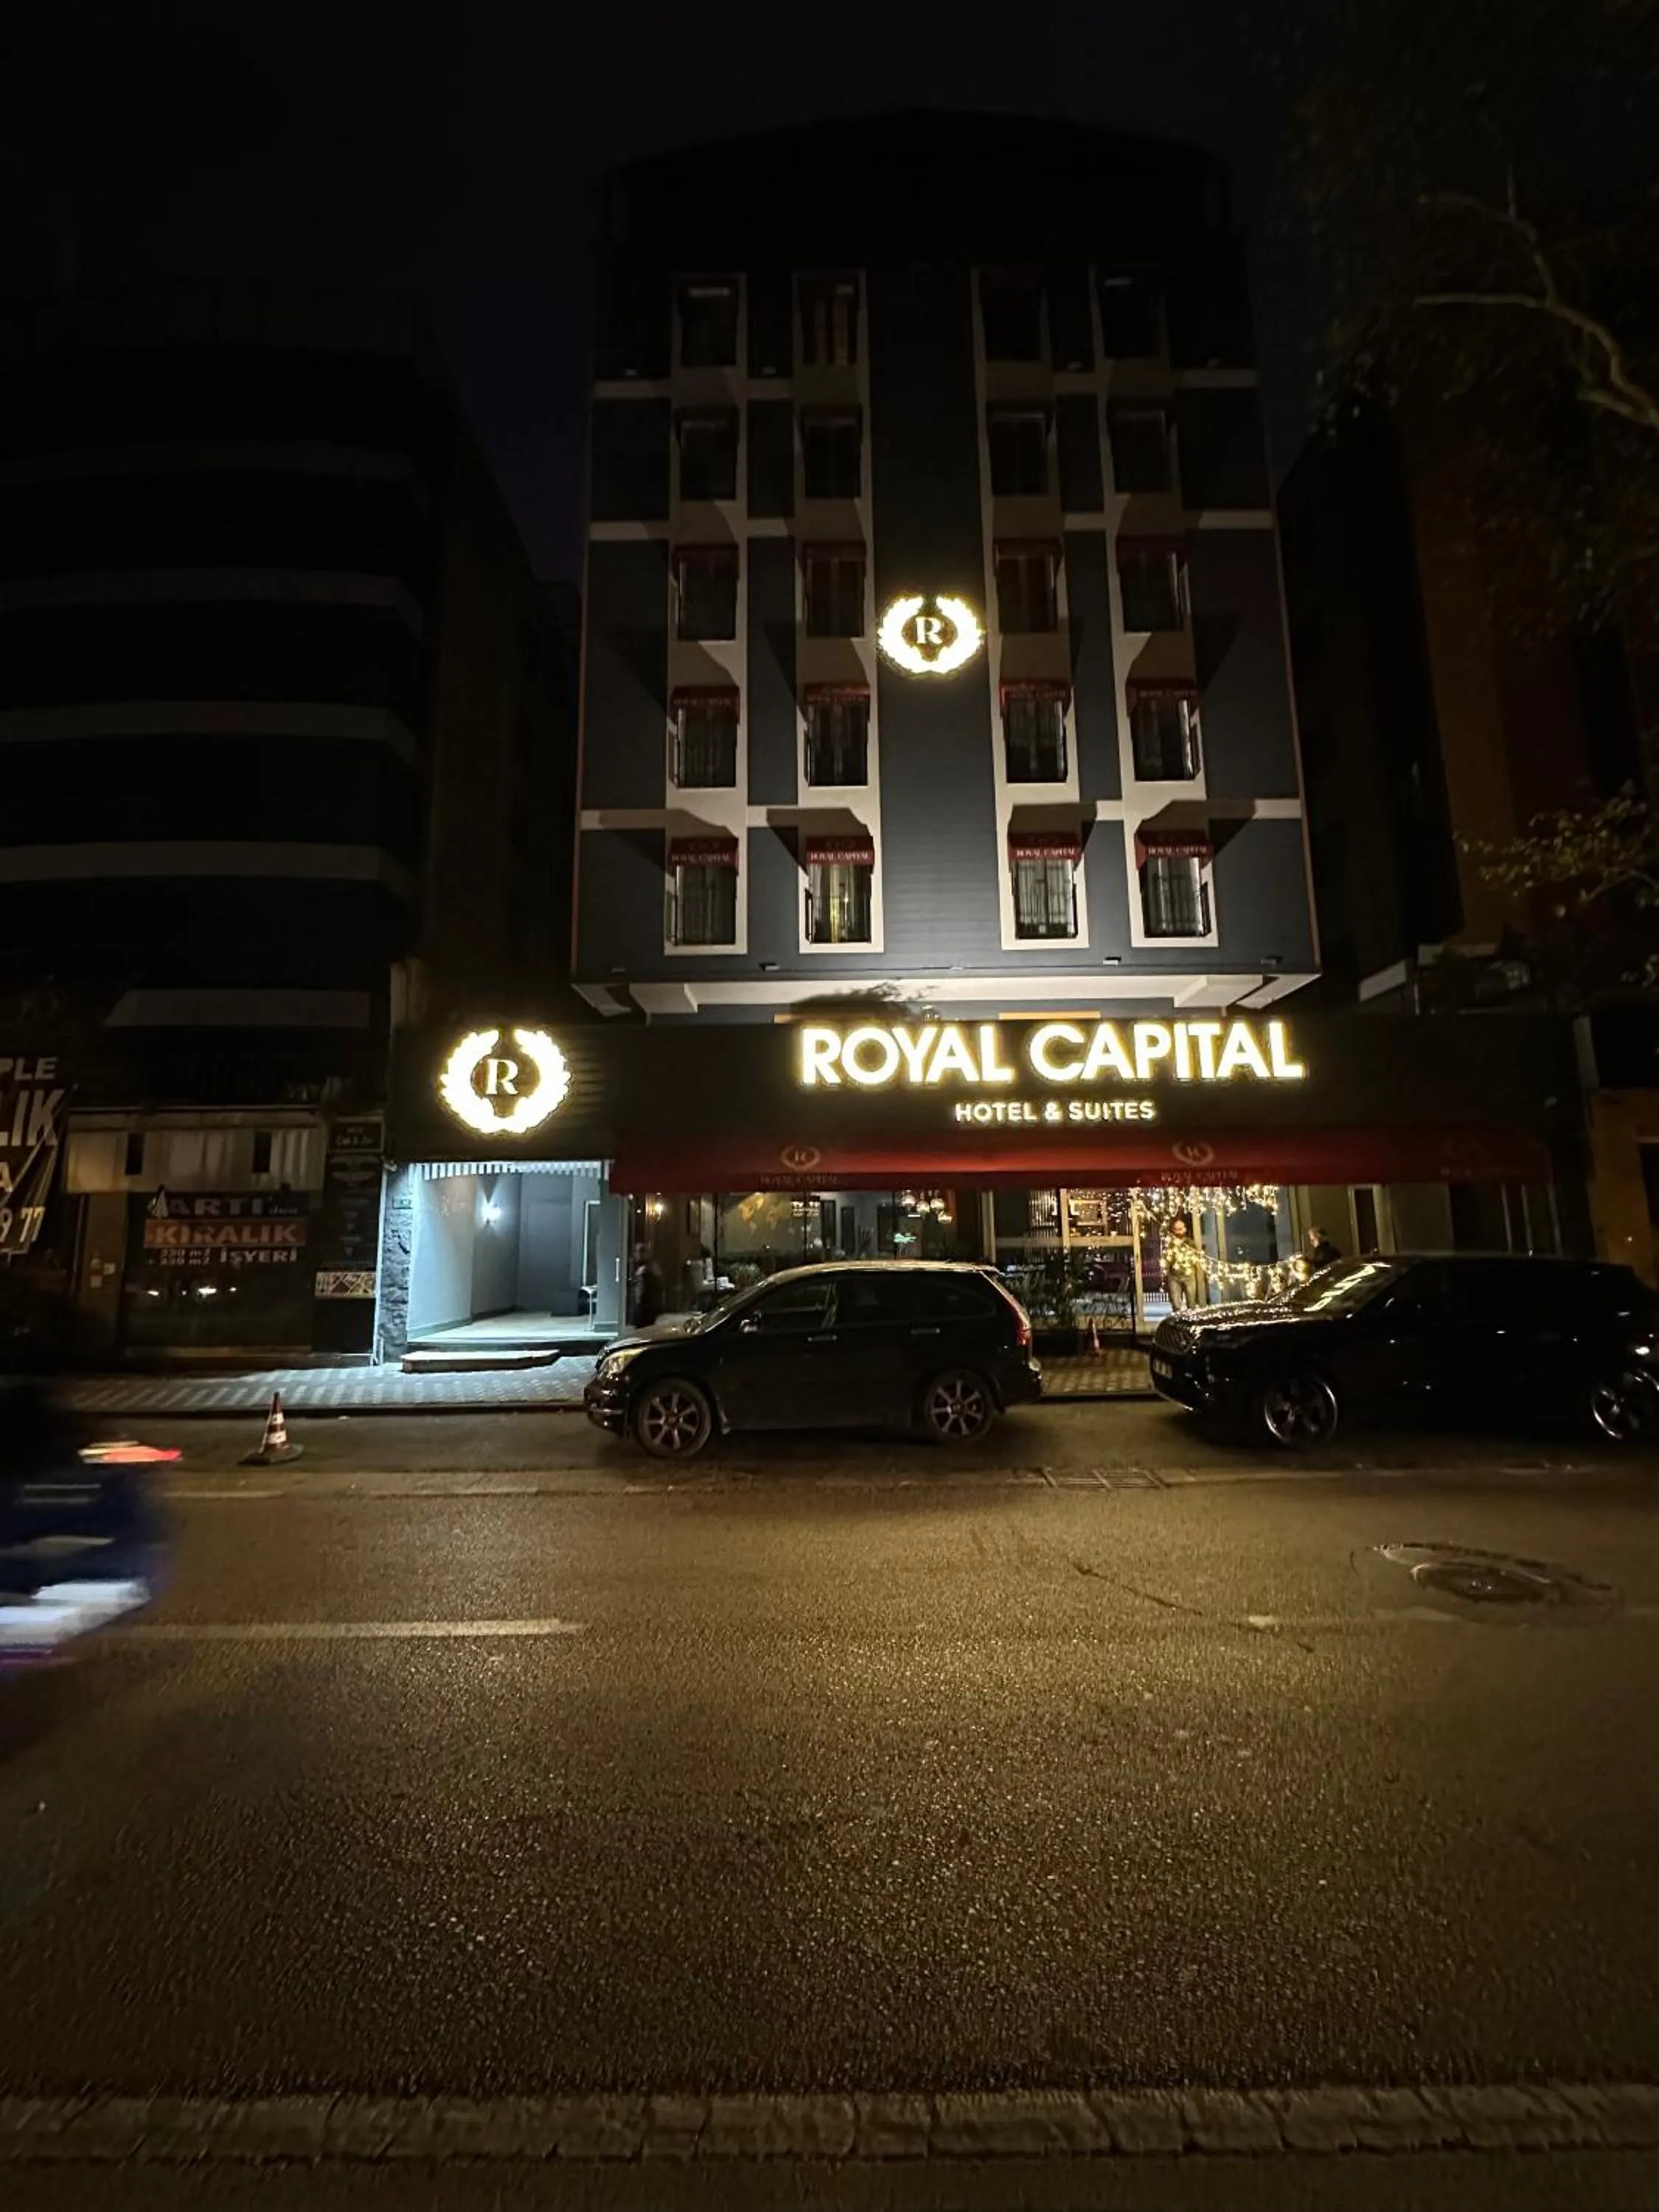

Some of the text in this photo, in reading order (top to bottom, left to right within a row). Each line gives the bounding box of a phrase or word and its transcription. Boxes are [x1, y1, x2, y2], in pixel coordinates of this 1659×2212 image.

[916, 616, 943, 644] R
[800, 1022, 1304, 1085] ROYAL CAPITAL
[485, 1058, 520, 1096] R
[956, 1102, 1155, 1123] HOTEL & SUITES
[167, 1197, 265, 1217] ARTI
